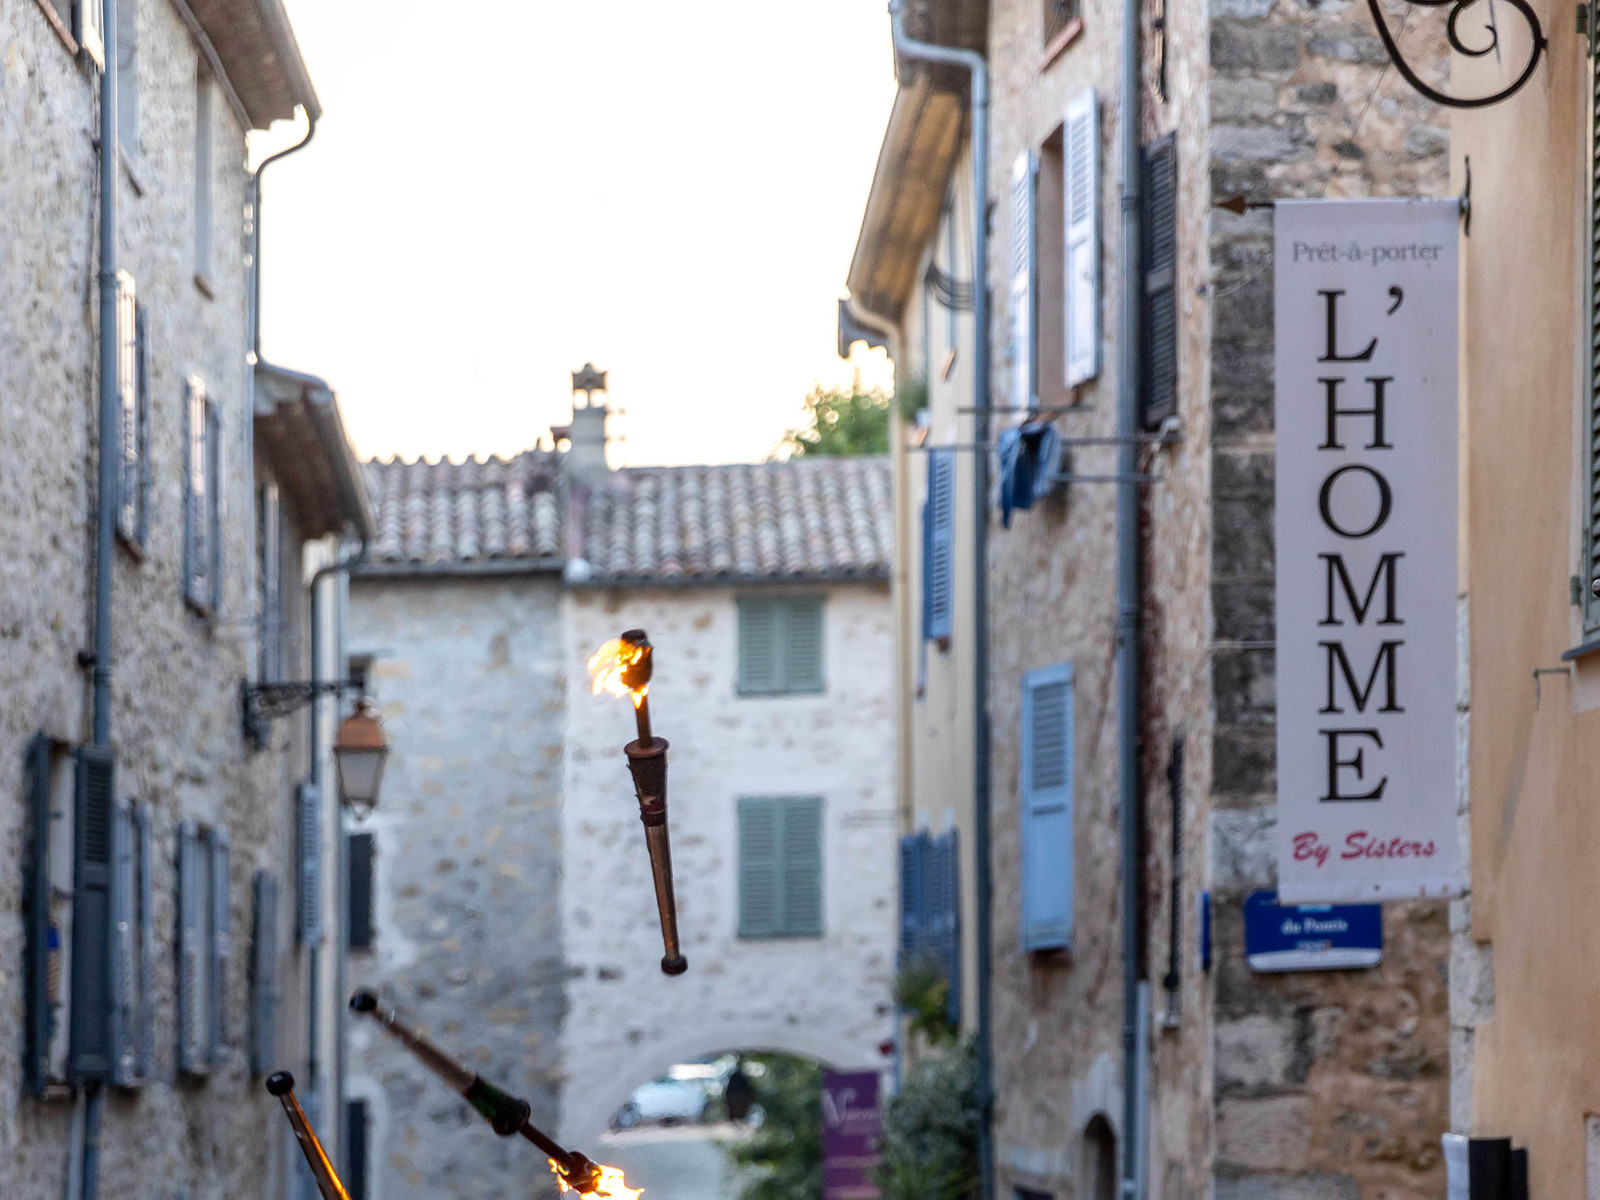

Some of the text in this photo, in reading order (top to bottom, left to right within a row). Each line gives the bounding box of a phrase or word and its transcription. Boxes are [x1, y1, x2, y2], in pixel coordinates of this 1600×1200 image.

[1292, 241, 1443, 267] Prêt-à-porter
[1292, 831, 1438, 868] By Sisters
